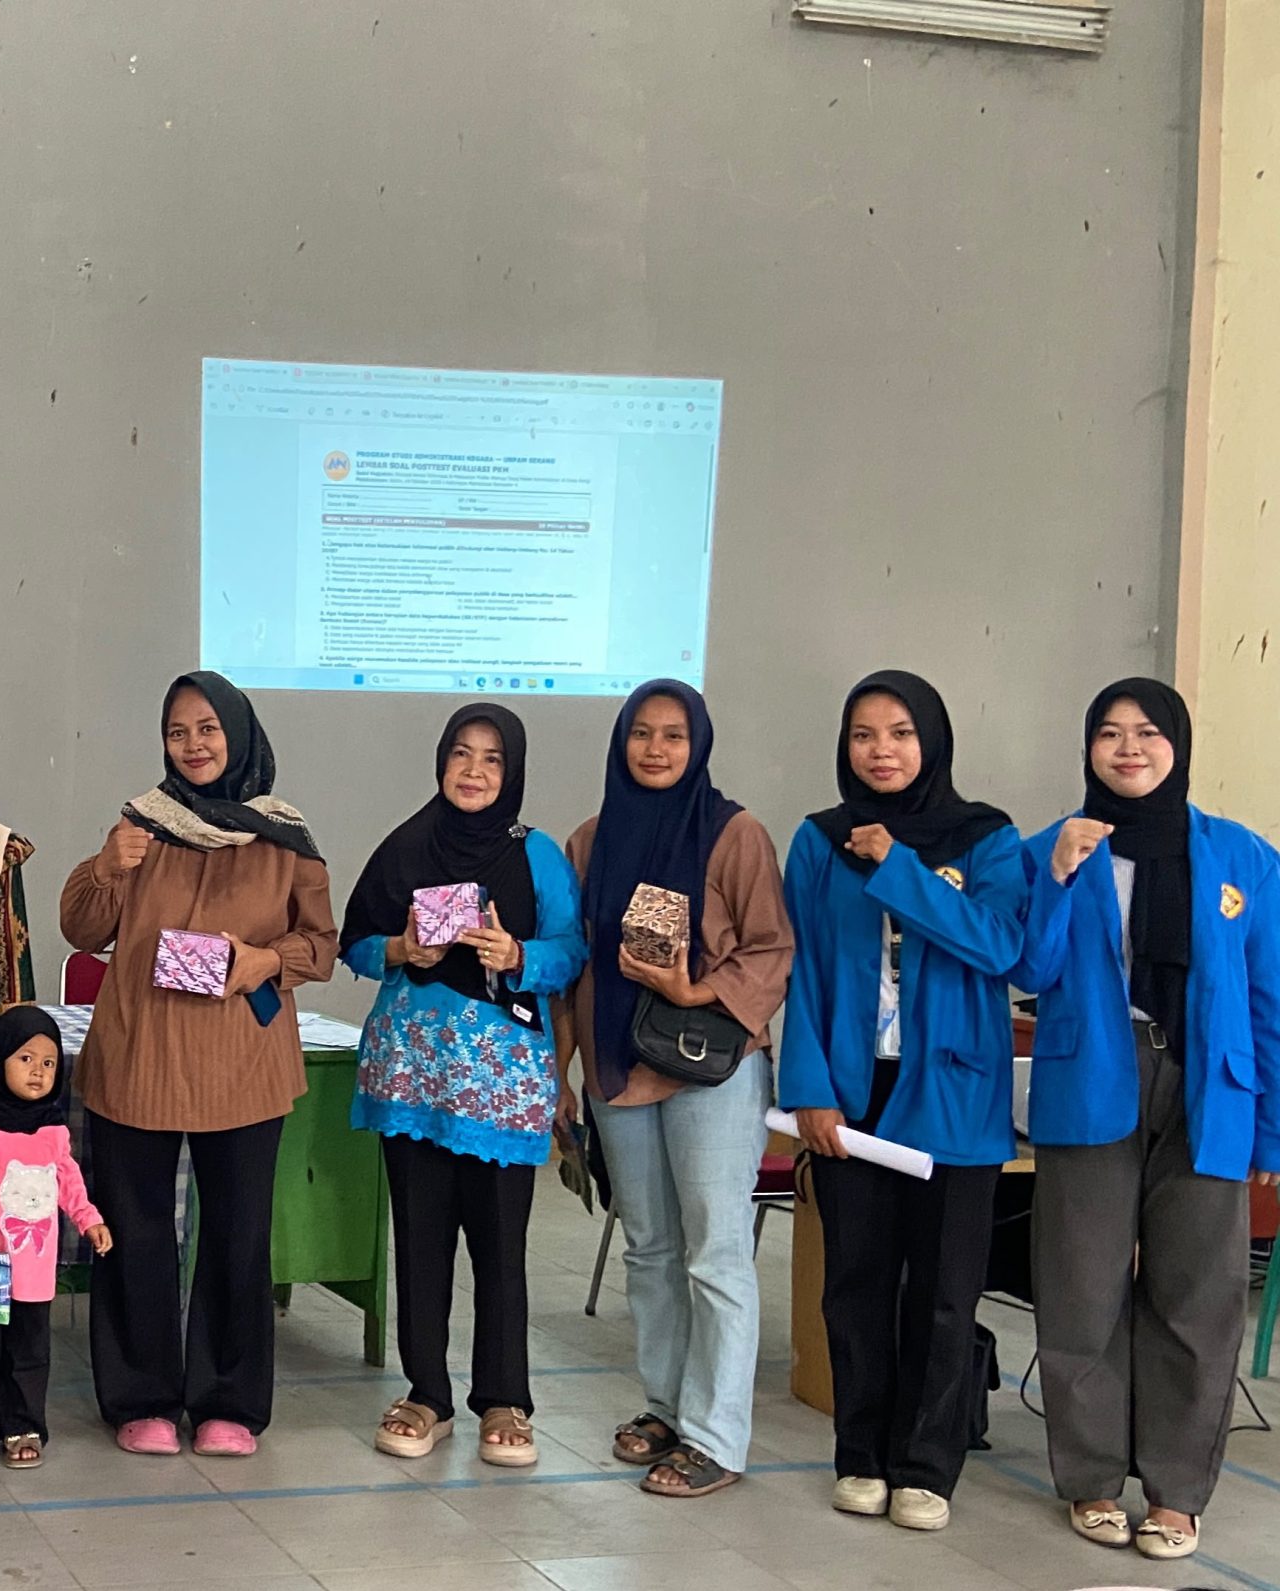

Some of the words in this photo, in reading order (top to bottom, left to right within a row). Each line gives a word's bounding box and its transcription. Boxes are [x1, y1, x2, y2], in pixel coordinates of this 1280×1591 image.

[389, 461, 410, 470] SOAL
[411, 463, 451, 472] POSTTEST
[452, 464, 491, 473] EVALUASI
